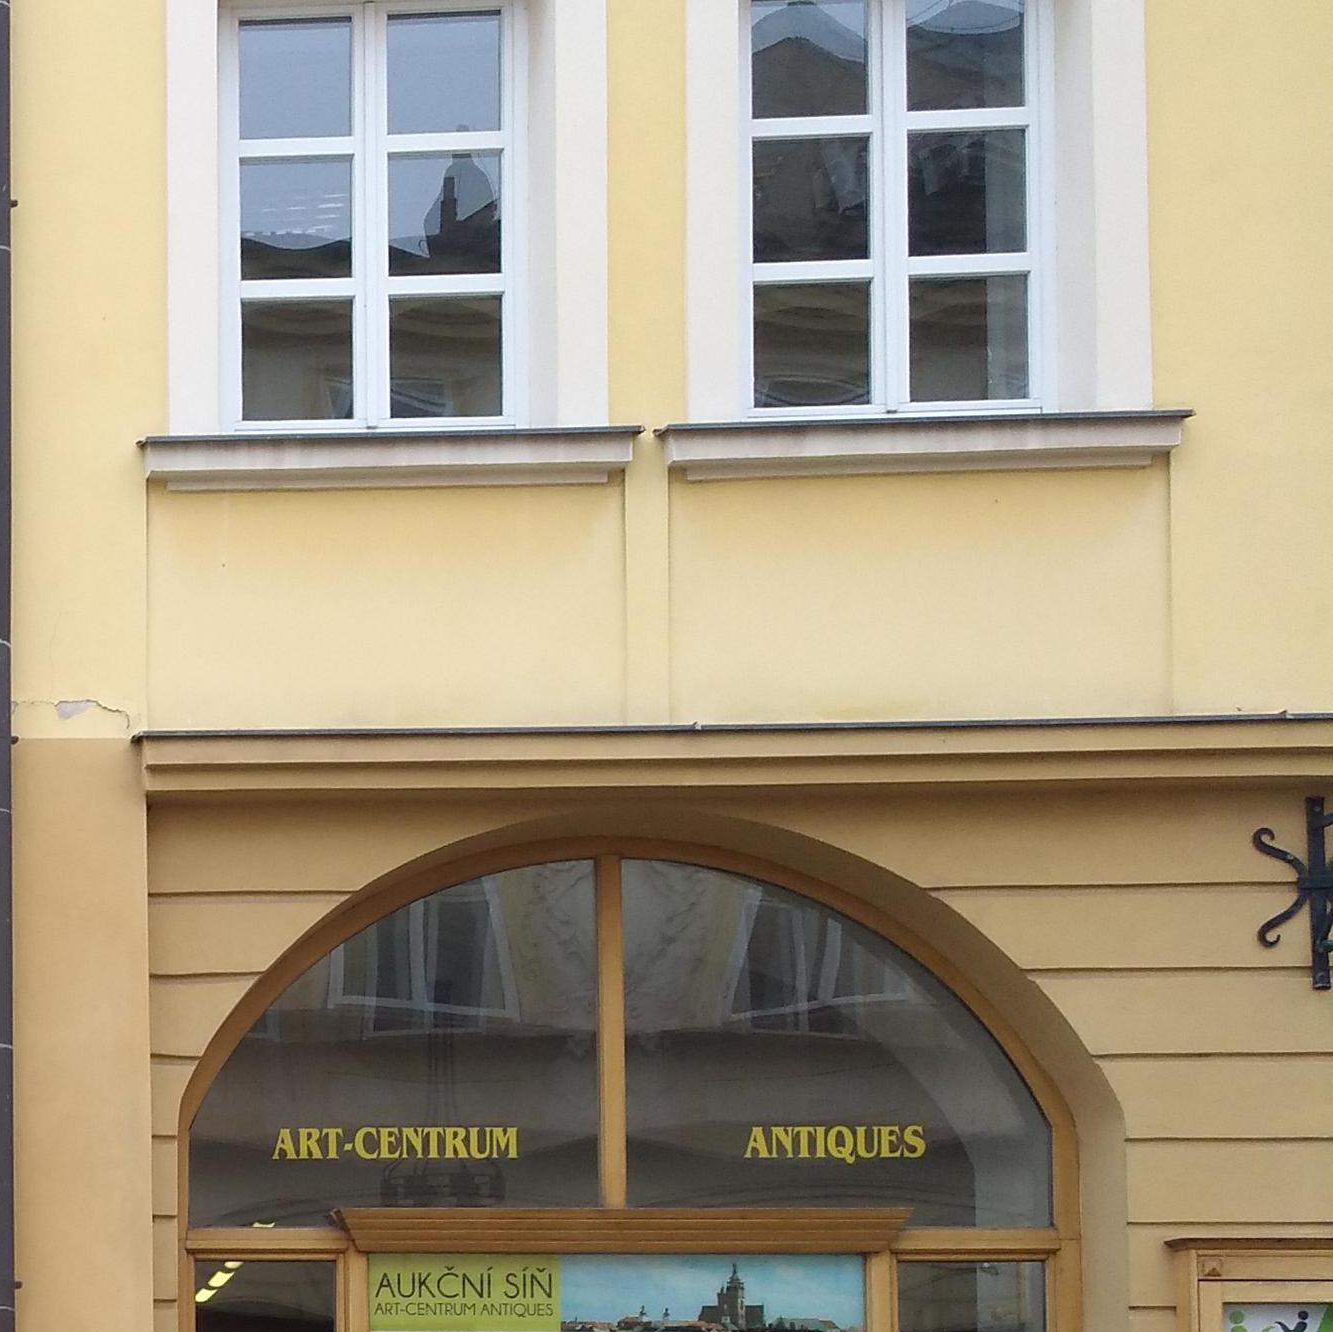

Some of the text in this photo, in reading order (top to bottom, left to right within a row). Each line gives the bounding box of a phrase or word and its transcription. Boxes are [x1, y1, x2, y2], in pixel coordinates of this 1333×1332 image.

[271, 1126, 520, 1160] ART-CENTRUM
[743, 1124, 927, 1164] ANTIQUES
[374, 1265, 553, 1299] AUKČNÍ SÍŇ
[373, 1301, 554, 1319] ART-CENTRUM ANTIQUES
